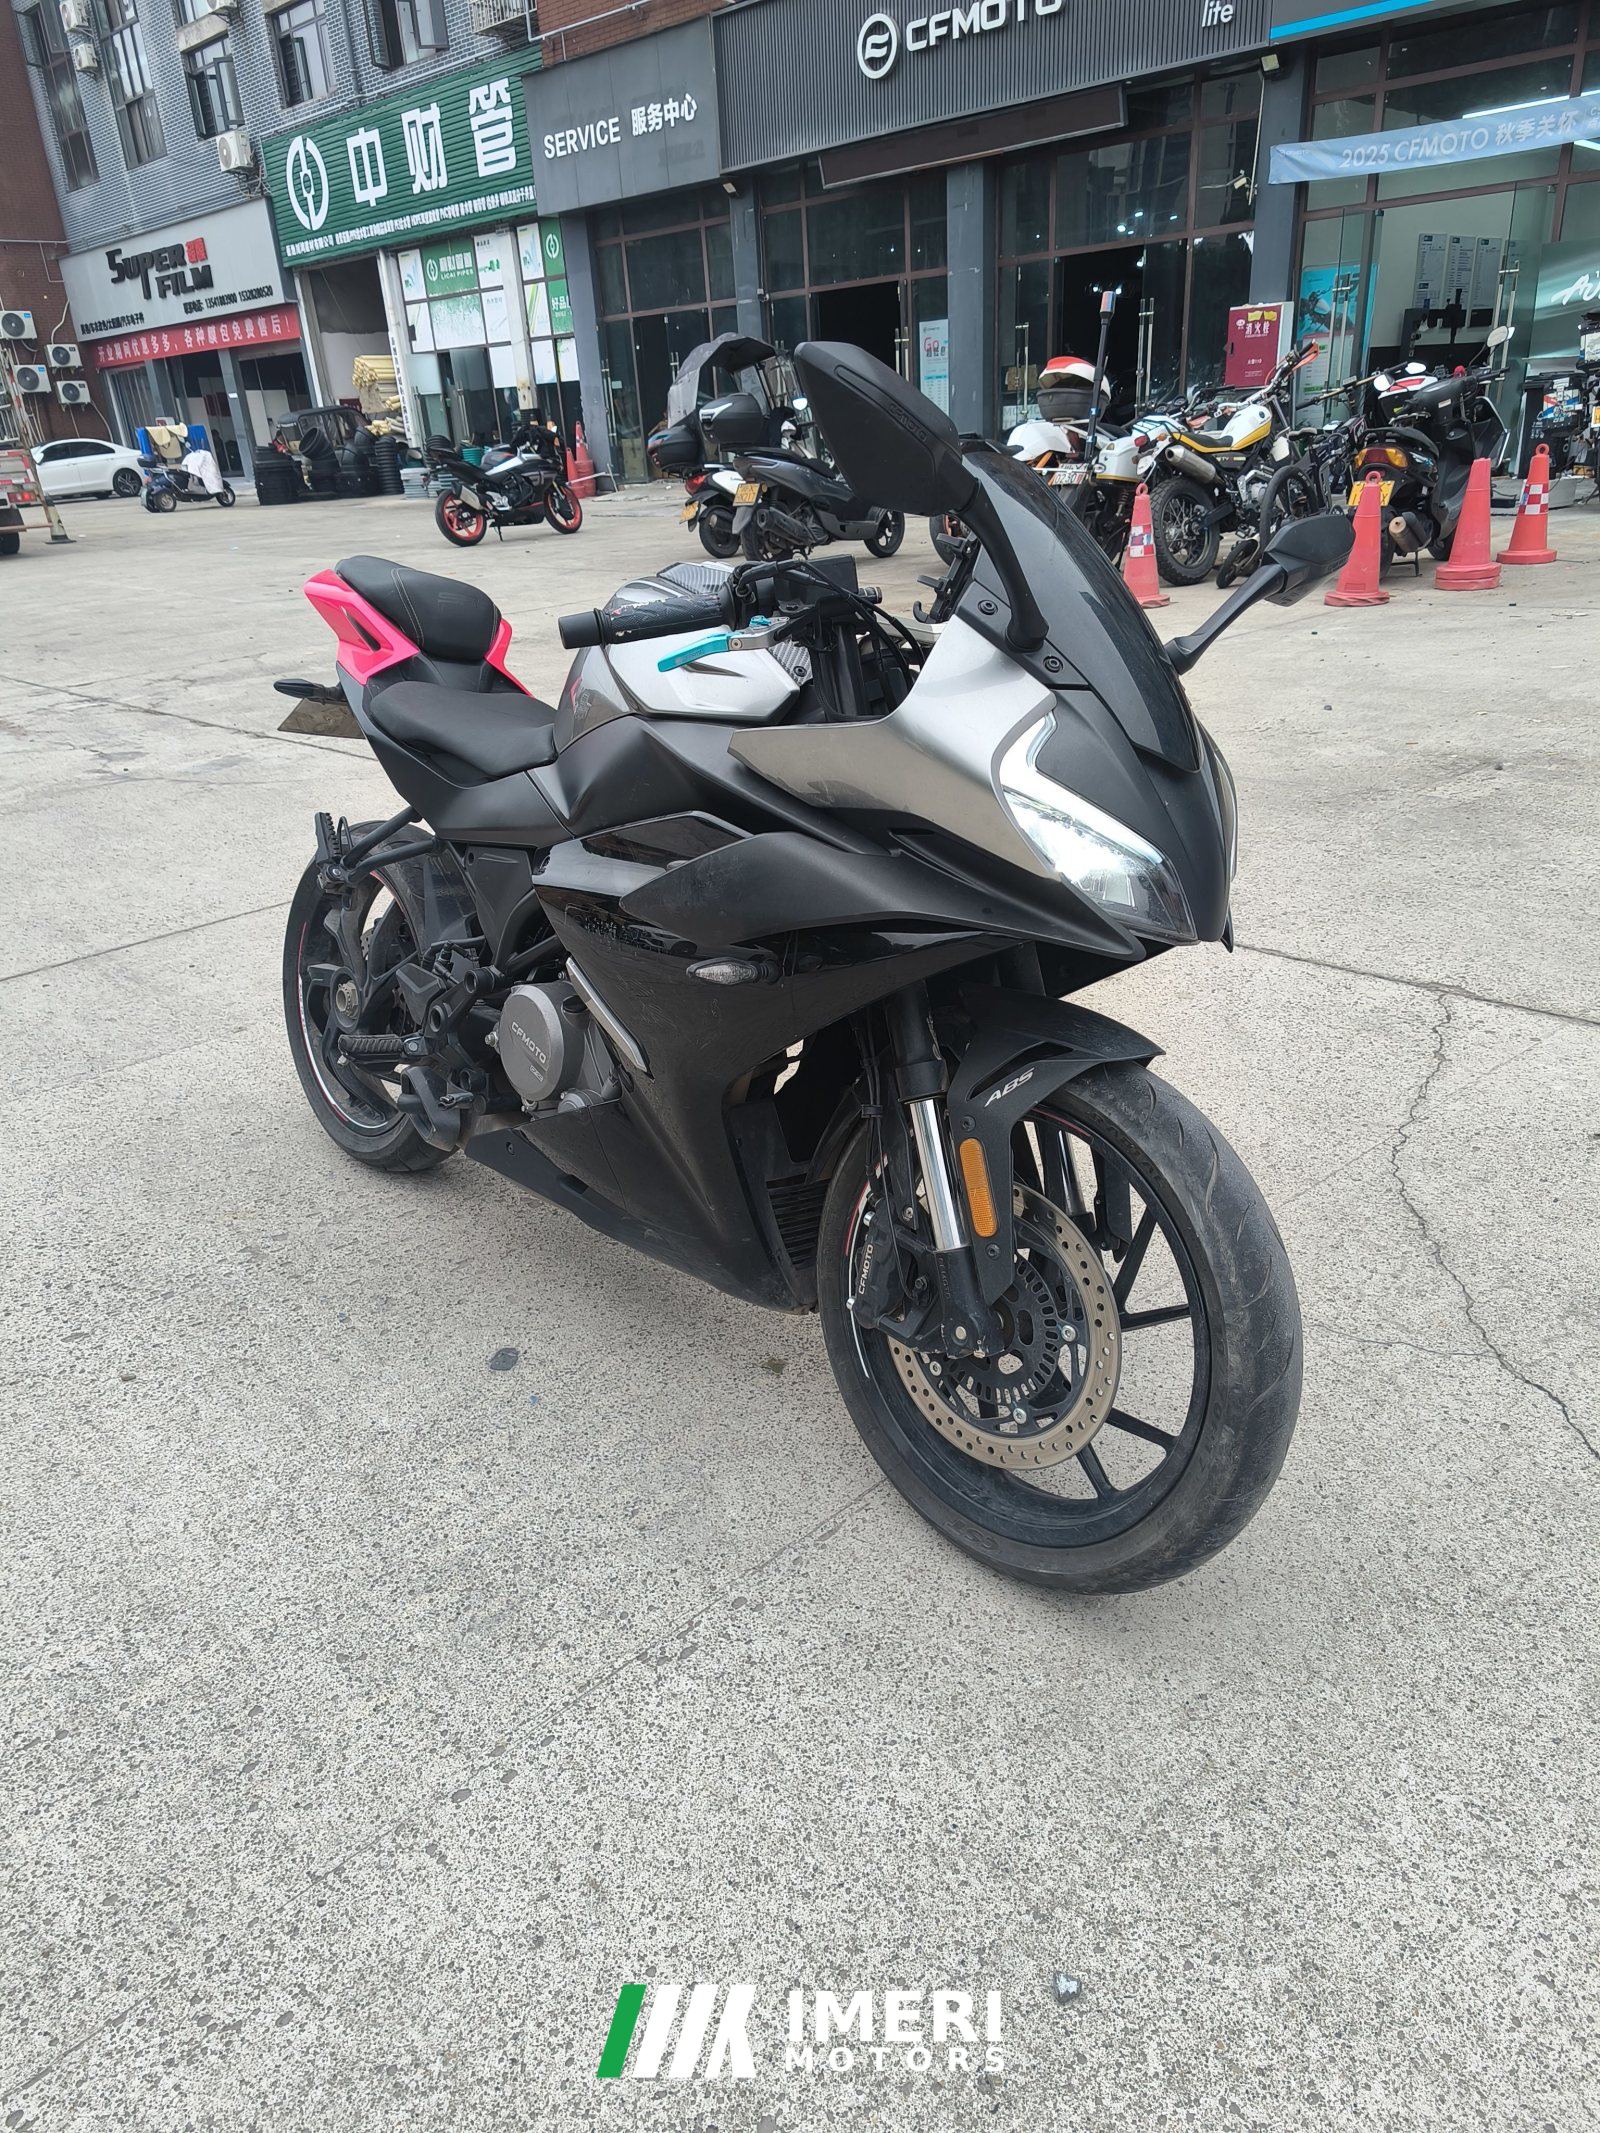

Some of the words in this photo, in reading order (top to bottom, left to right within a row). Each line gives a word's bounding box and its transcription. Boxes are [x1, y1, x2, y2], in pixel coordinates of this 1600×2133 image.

[543, 117, 622, 159] SERVICE
[631, 93, 698, 136] 服务中心
[1338, 144, 1390, 169] 2025
[1394, 126, 1489, 162] CFMOTO
[105, 243, 187, 300] SUPER
[155, 264, 215, 300] FILM
[511, 1021, 547, 1064] CFMOTO
[984, 1067, 1035, 1108] ABS
[858, 1244, 874, 1295] CFMOTO
